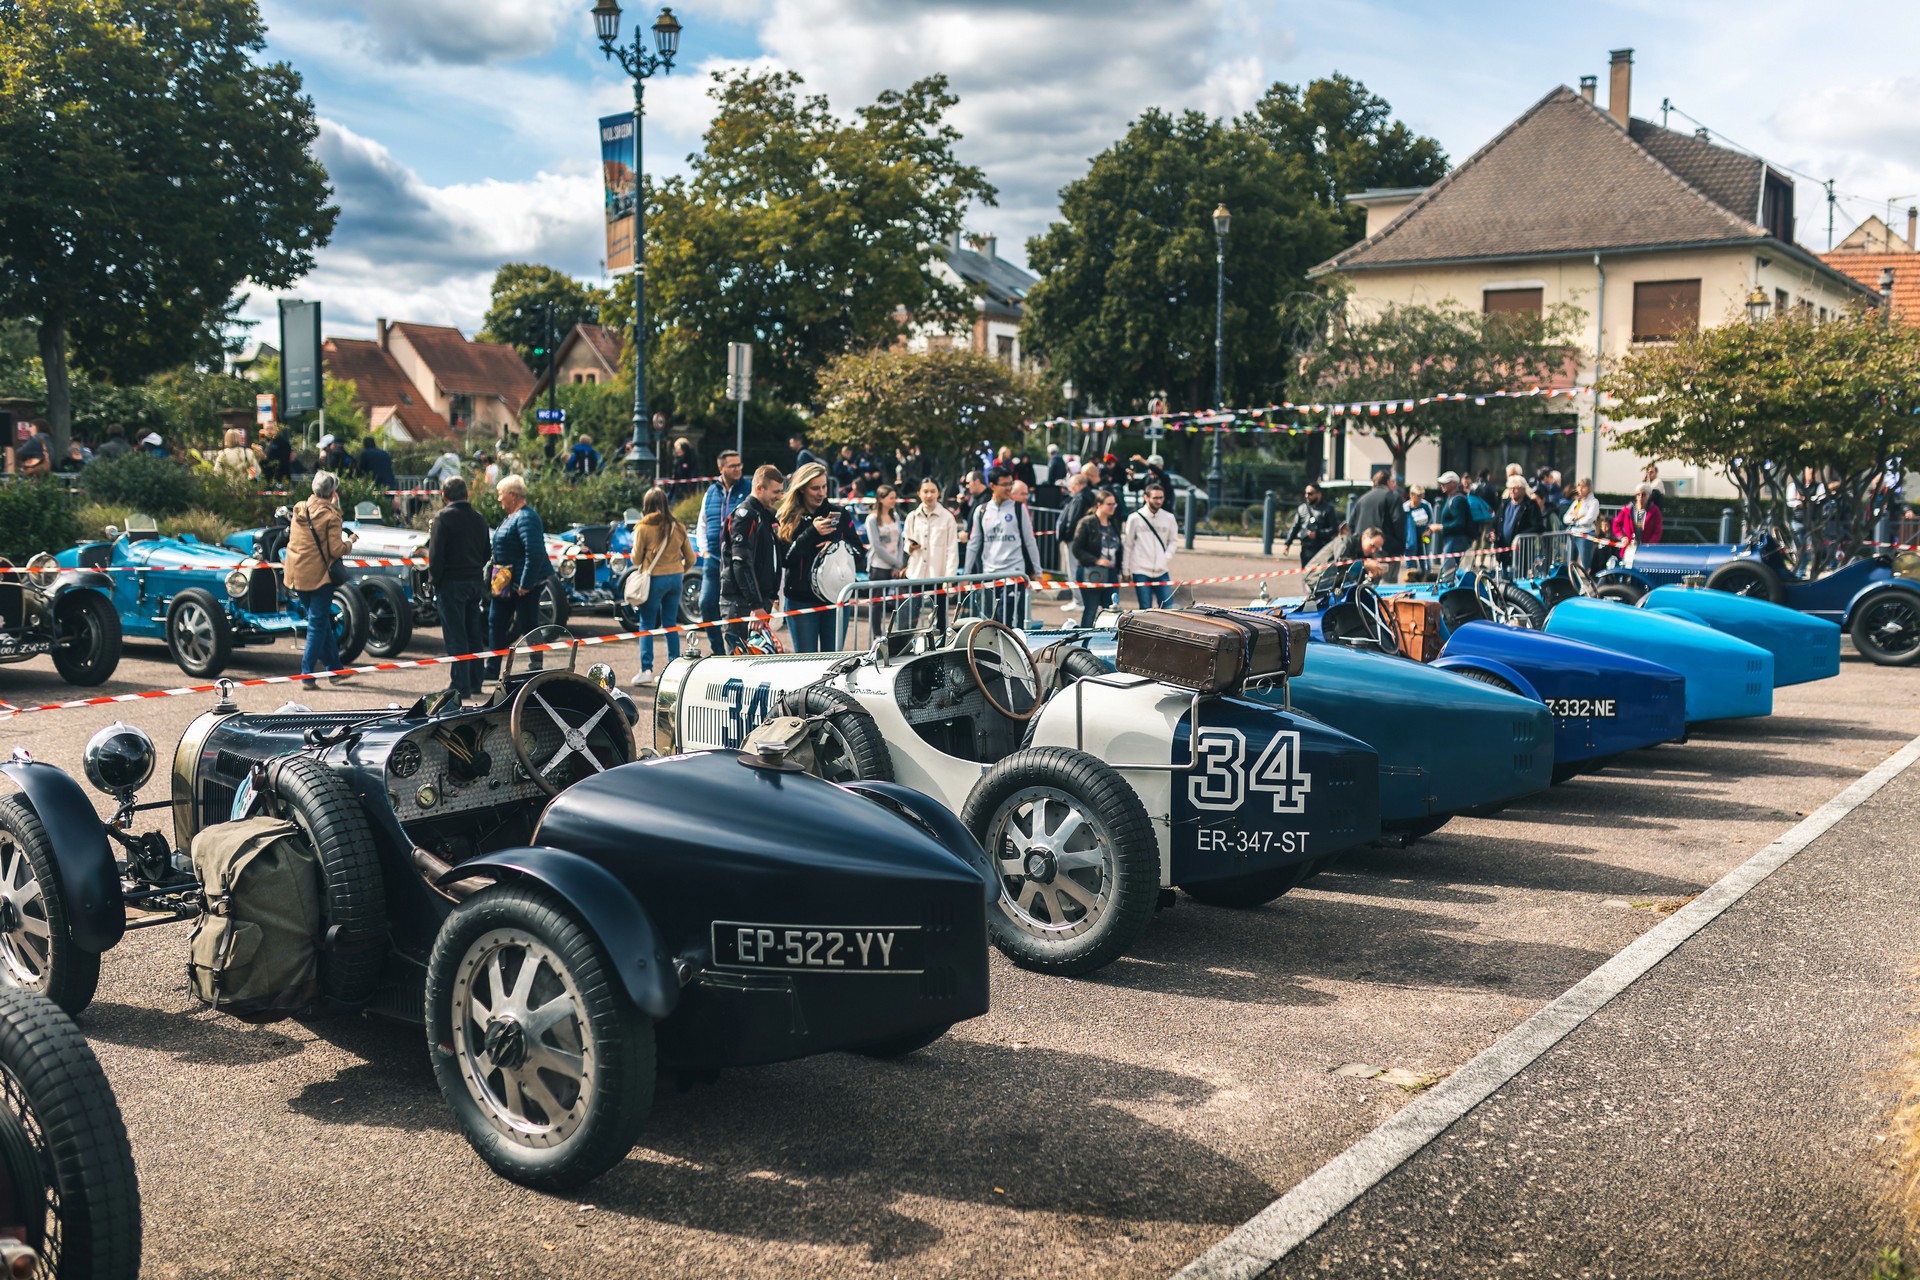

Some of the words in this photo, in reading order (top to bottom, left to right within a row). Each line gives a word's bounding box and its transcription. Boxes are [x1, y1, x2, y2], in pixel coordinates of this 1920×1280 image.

[722, 678, 771, 749] 34
[1188, 726, 1311, 813] 34
[1197, 829, 1310, 853] ER-347-ST
[737, 928, 895, 967] EP-522-YY
